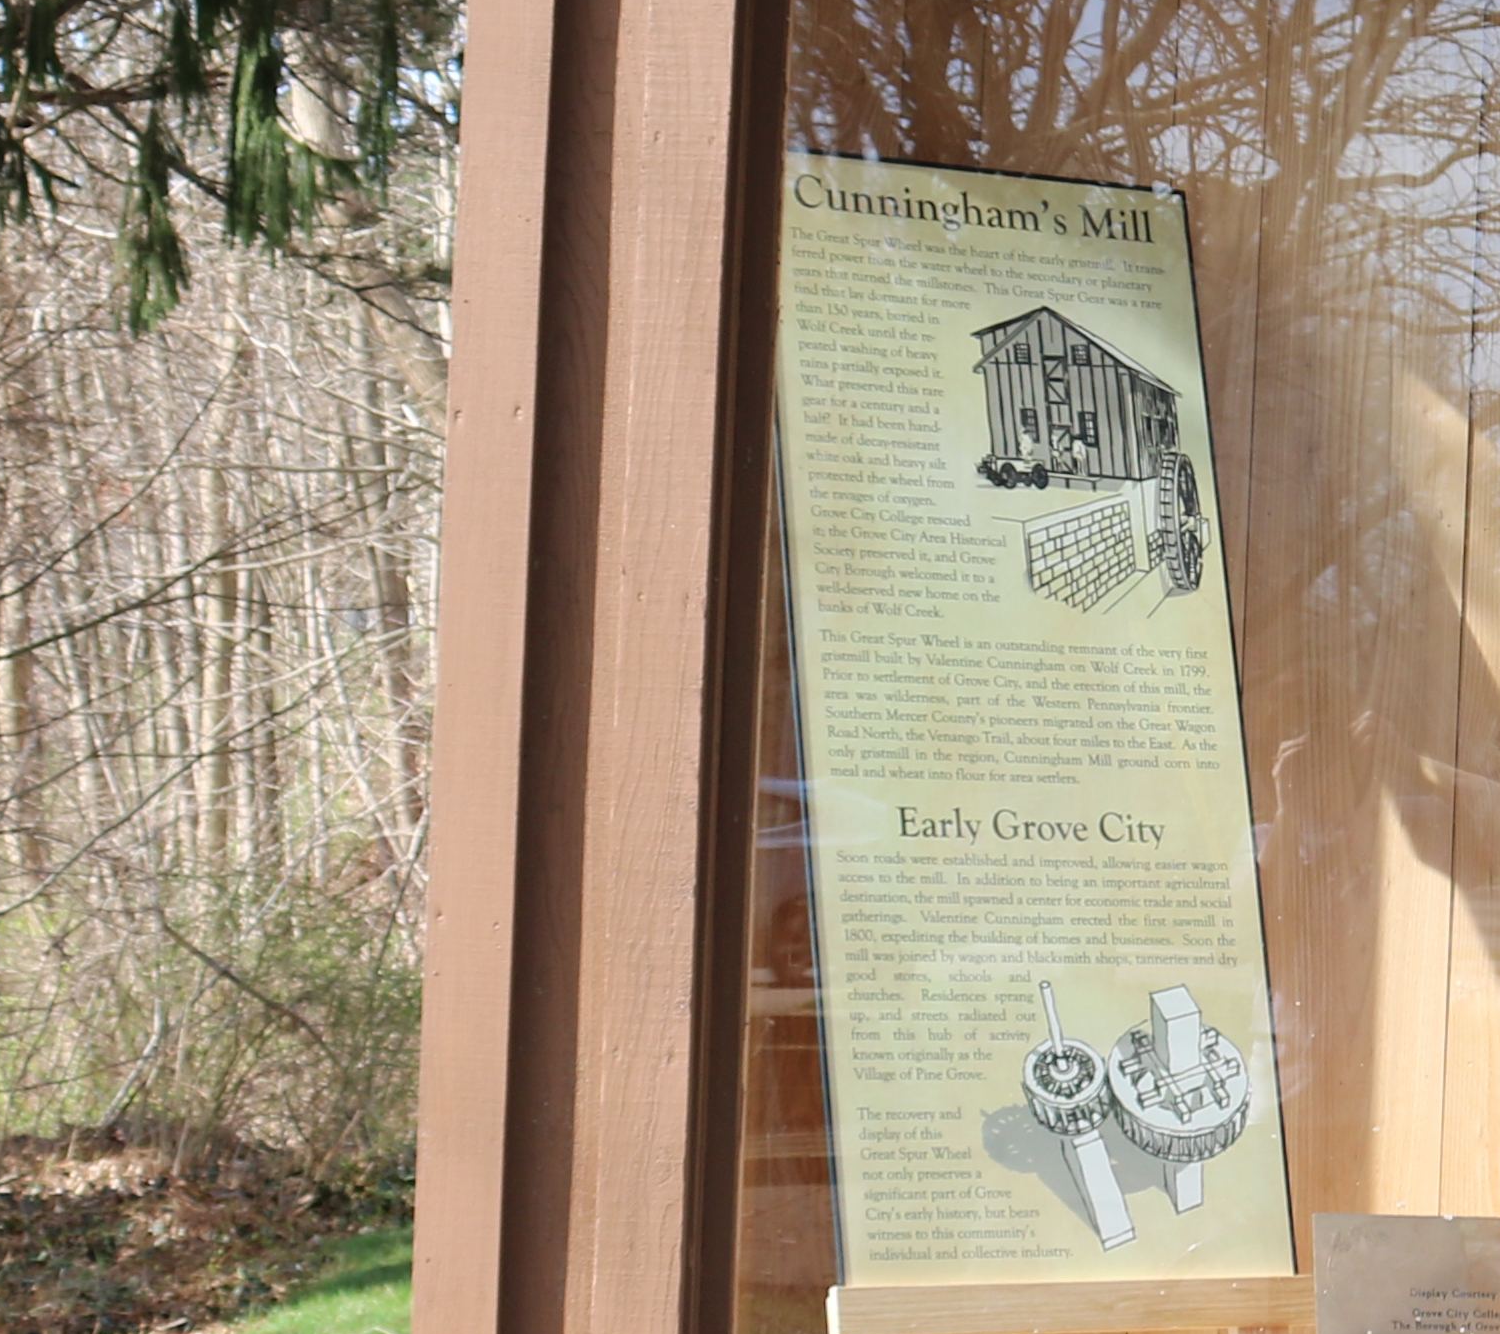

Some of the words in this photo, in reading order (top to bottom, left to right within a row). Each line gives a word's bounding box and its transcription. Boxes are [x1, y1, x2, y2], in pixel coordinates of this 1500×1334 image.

[793, 173, 1068, 235] Cunningham's
[1081, 203, 1155, 244] Mill
[795, 301, 822, 314] than
[851, 309, 883, 323] years,
[886, 309, 924, 323] buried
[795, 319, 826, 333] Wolf
[828, 322, 865, 336] Creek
[867, 325, 896, 338] until
[804, 411, 831, 424] half?
[876, 416, 905, 430] been
[908, 419, 941, 432] hand-
[805, 429, 837, 443] made
[856, 433, 940, 453] decay-resistant
[810, 504, 847, 518] Grove
[849, 507, 875, 523] City
[878, 509, 924, 526] College
[926, 512, 971, 526] rescued
[850, 526, 887, 540] Grove
[889, 528, 917, 545] City
[918, 530, 947, 544] Area
[949, 532, 1007, 547] Historical
[812, 543, 857, 560] Society
[858, 545, 916, 563] preserved
[958, 551, 997, 565] Grove
[814, 562, 840, 578] City
[844, 563, 896, 581] Borough
[898, 566, 957, 581] welcomed
[816, 581, 894, 597] well-deserved
[925, 587, 959, 600] home
[818, 629, 847, 643] This
[849, 631, 885, 644] Great
[887, 633, 917, 649] Spur
[919, 634, 960, 648] Wheel
[994, 638, 1065, 656] outstanding
[1067, 643, 1117, 656] remnant
[1157, 649, 1183, 662] very
[1184, 647, 1208, 660] first
[820, 648, 870, 666] gristmill
[874, 651, 902, 664] built
[925, 653, 982, 668] Valentine
[986, 656, 1065, 675] Cunningham
[1090, 661, 1119, 674] Wolf
[1122, 663, 1157, 676] Creek
[1180, 665, 1209, 678] 1799.
[825, 706, 882, 721] Southern
[885, 709, 928, 722] Mercer
[930, 710, 986, 728] County's
[988, 713, 1039, 730] pioneers
[1042, 715, 1094, 732] migrated
[1137, 719, 1172, 732] Great
[1174, 720, 1216, 737] Wagon
[896, 805, 982, 845] Early
[992, 808, 1088, 843] Grove
[1098, 811, 1166, 850] City
[836, 850, 868, 863] Soon
[873, 851, 906, 864] roads
[909, 855, 938, 865] were
[941, 852, 1008, 866] established
[1038, 855, 1098, 871] improved,
[1101, 856, 1151, 873] allowing
[1153, 858, 1187, 870] easier
[1190, 862, 1229, 874] wagon
[853, 1067, 896, 1084] Village
[915, 1067, 942, 1080] Pine
[945, 1067, 986, 1080] Grove.
[885, 1110, 935, 1123] recovery
[858, 1126, 901, 1144] display
[919, 1126, 943, 1139] this
[859, 1147, 896, 1160] Great
[897, 1146, 929, 1164] Spur
[930, 1146, 972, 1160] Wheel
[886, 1166, 914, 1184] only
[916, 1169, 972, 1183] preserves
[863, 1186, 927, 1204] significant
[930, 1187, 956, 1203] part
[974, 1185, 1012, 1199] Grove
[864, 1207, 901, 1225] City's
[903, 1206, 933, 1224] early
[936, 1205, 981, 1223] history,
[1008, 1204, 1040, 1218] bears
[869, 1246, 931, 1261] individual
[961, 1245, 1017, 1259] collective
[1020, 1244, 1074, 1262] industry.
[1410, 1288, 1447, 1300] Display
[1452, 1289, 1496, 1301] Courtesy
[1412, 1308, 1442, 1317] Grove
[1446, 1308, 1469, 1320] City
[1391, 1320, 1410, 1330] The
[1415, 1320, 1456, 1333] Borough
